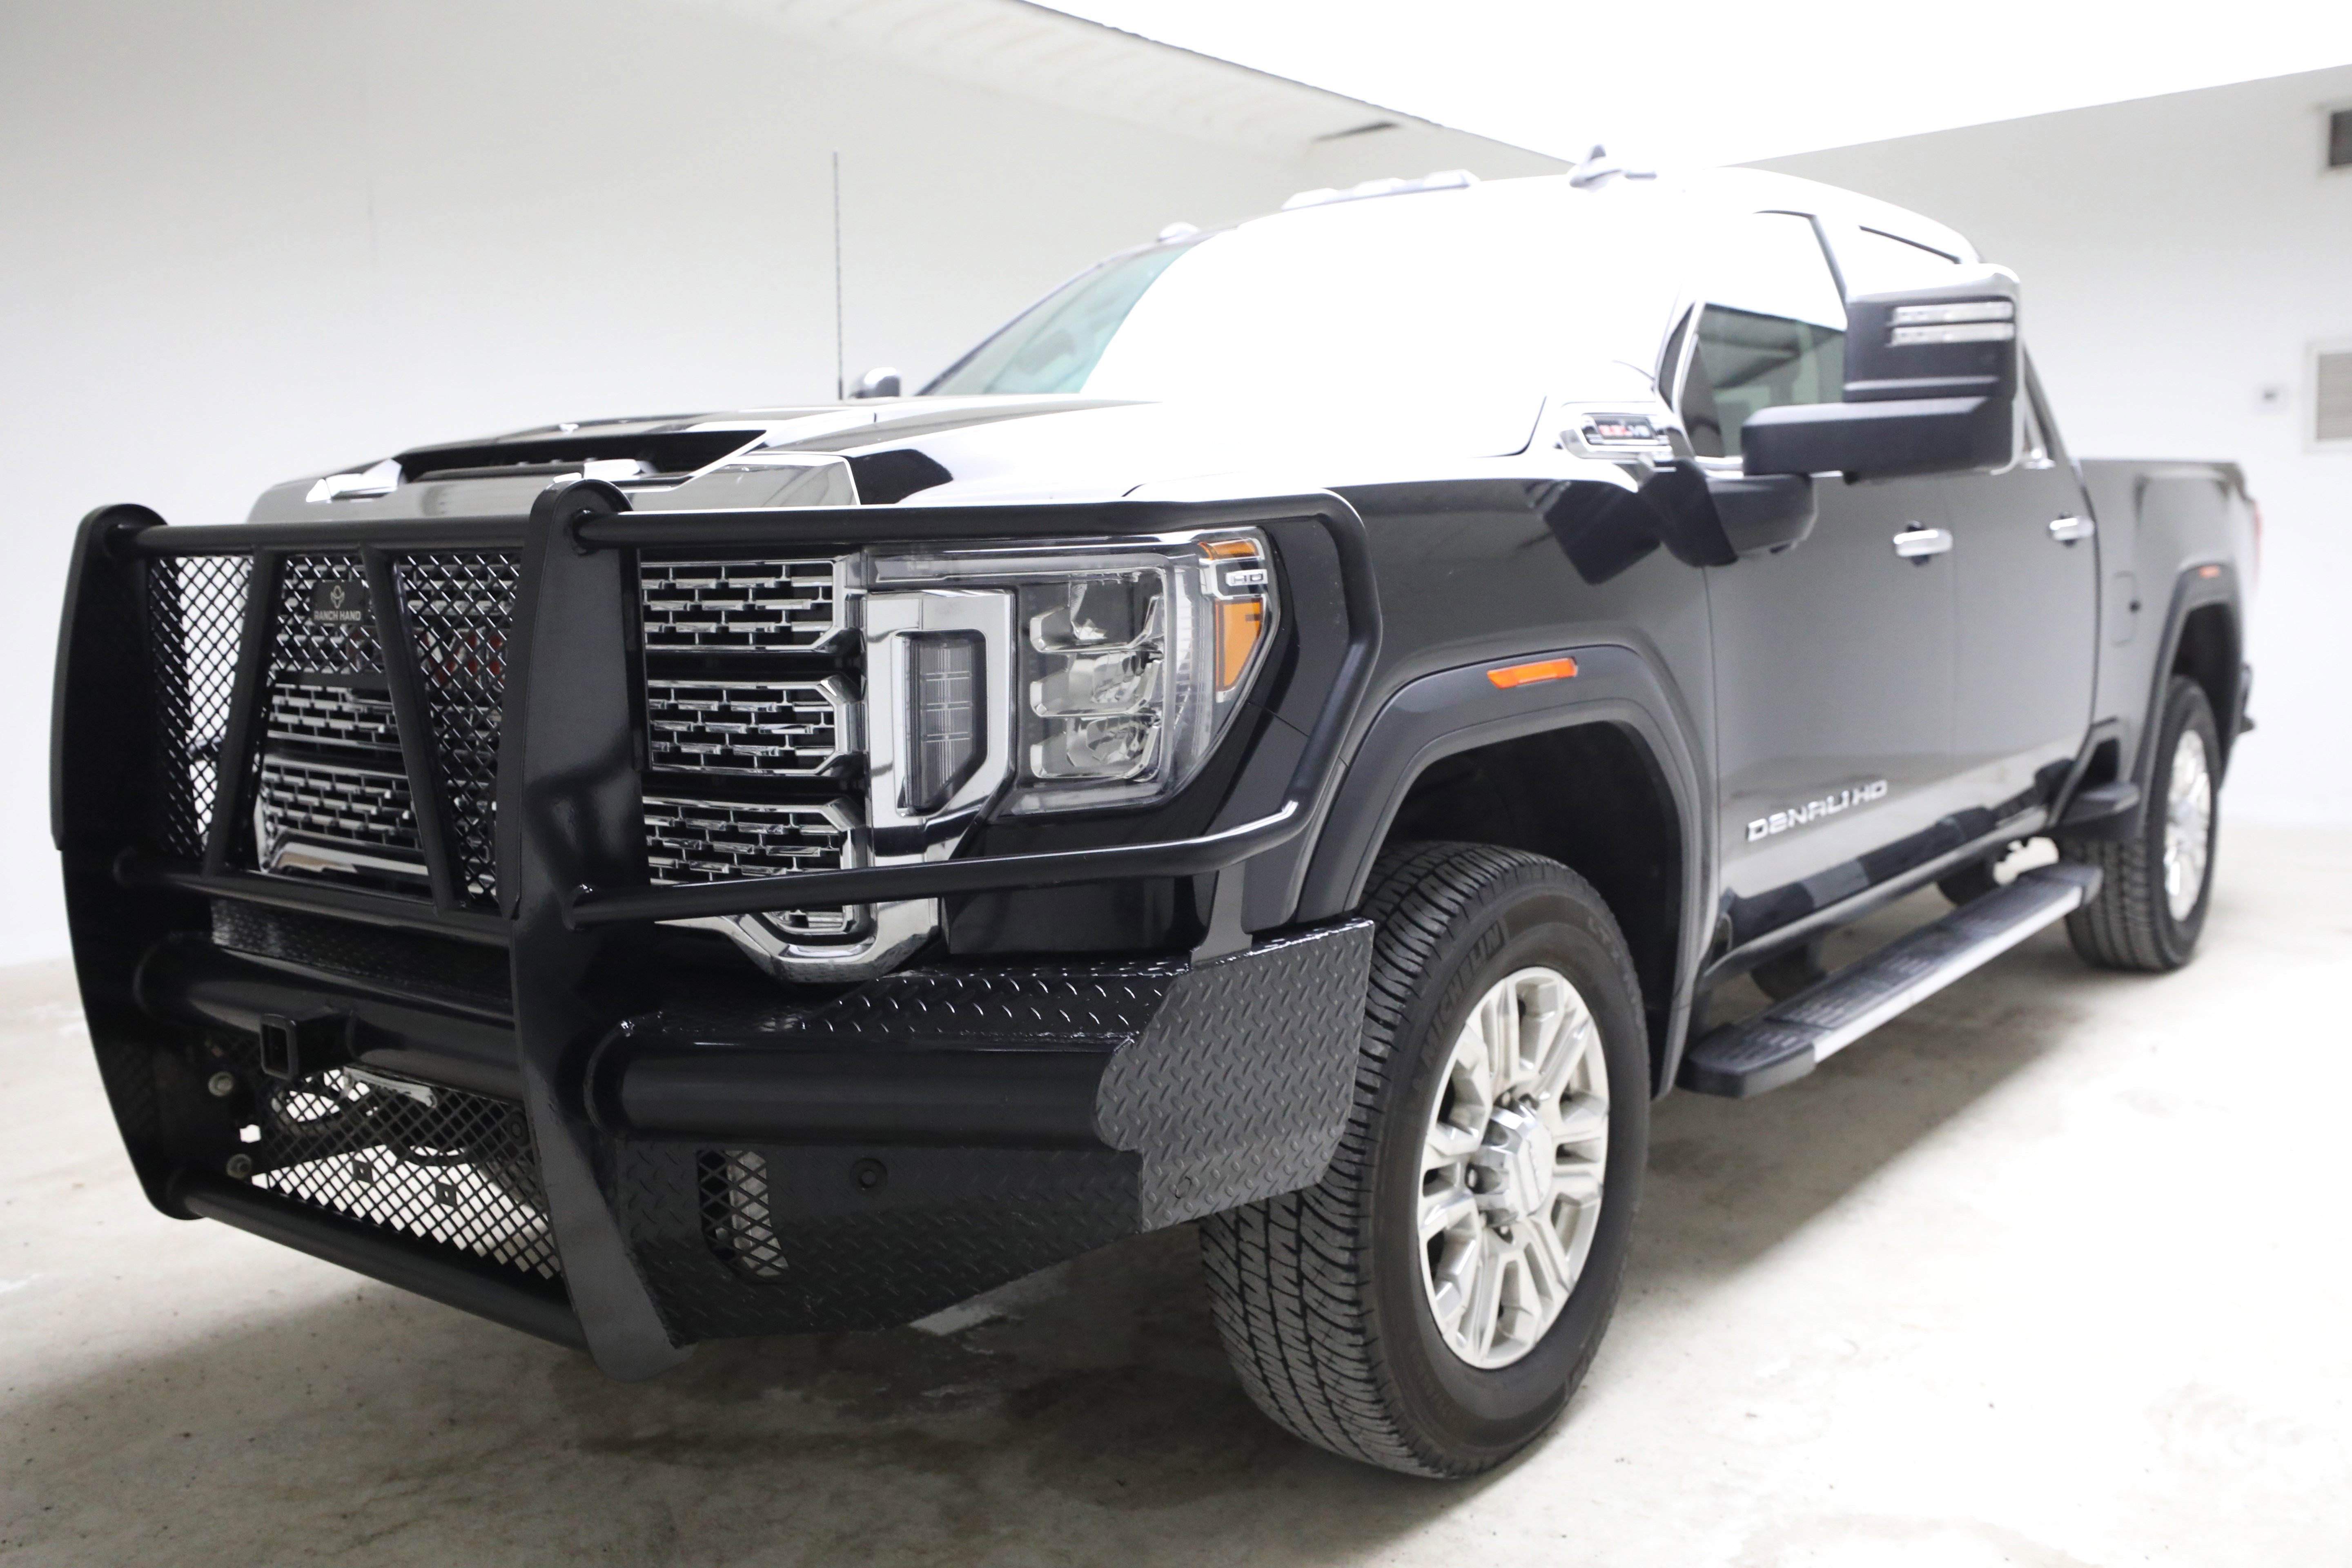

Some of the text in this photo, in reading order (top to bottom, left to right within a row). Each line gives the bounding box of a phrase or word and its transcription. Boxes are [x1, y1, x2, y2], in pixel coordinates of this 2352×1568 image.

[314, 610, 362, 621] RANCH HAND
[1746, 779, 1888, 842] DENALI HD
